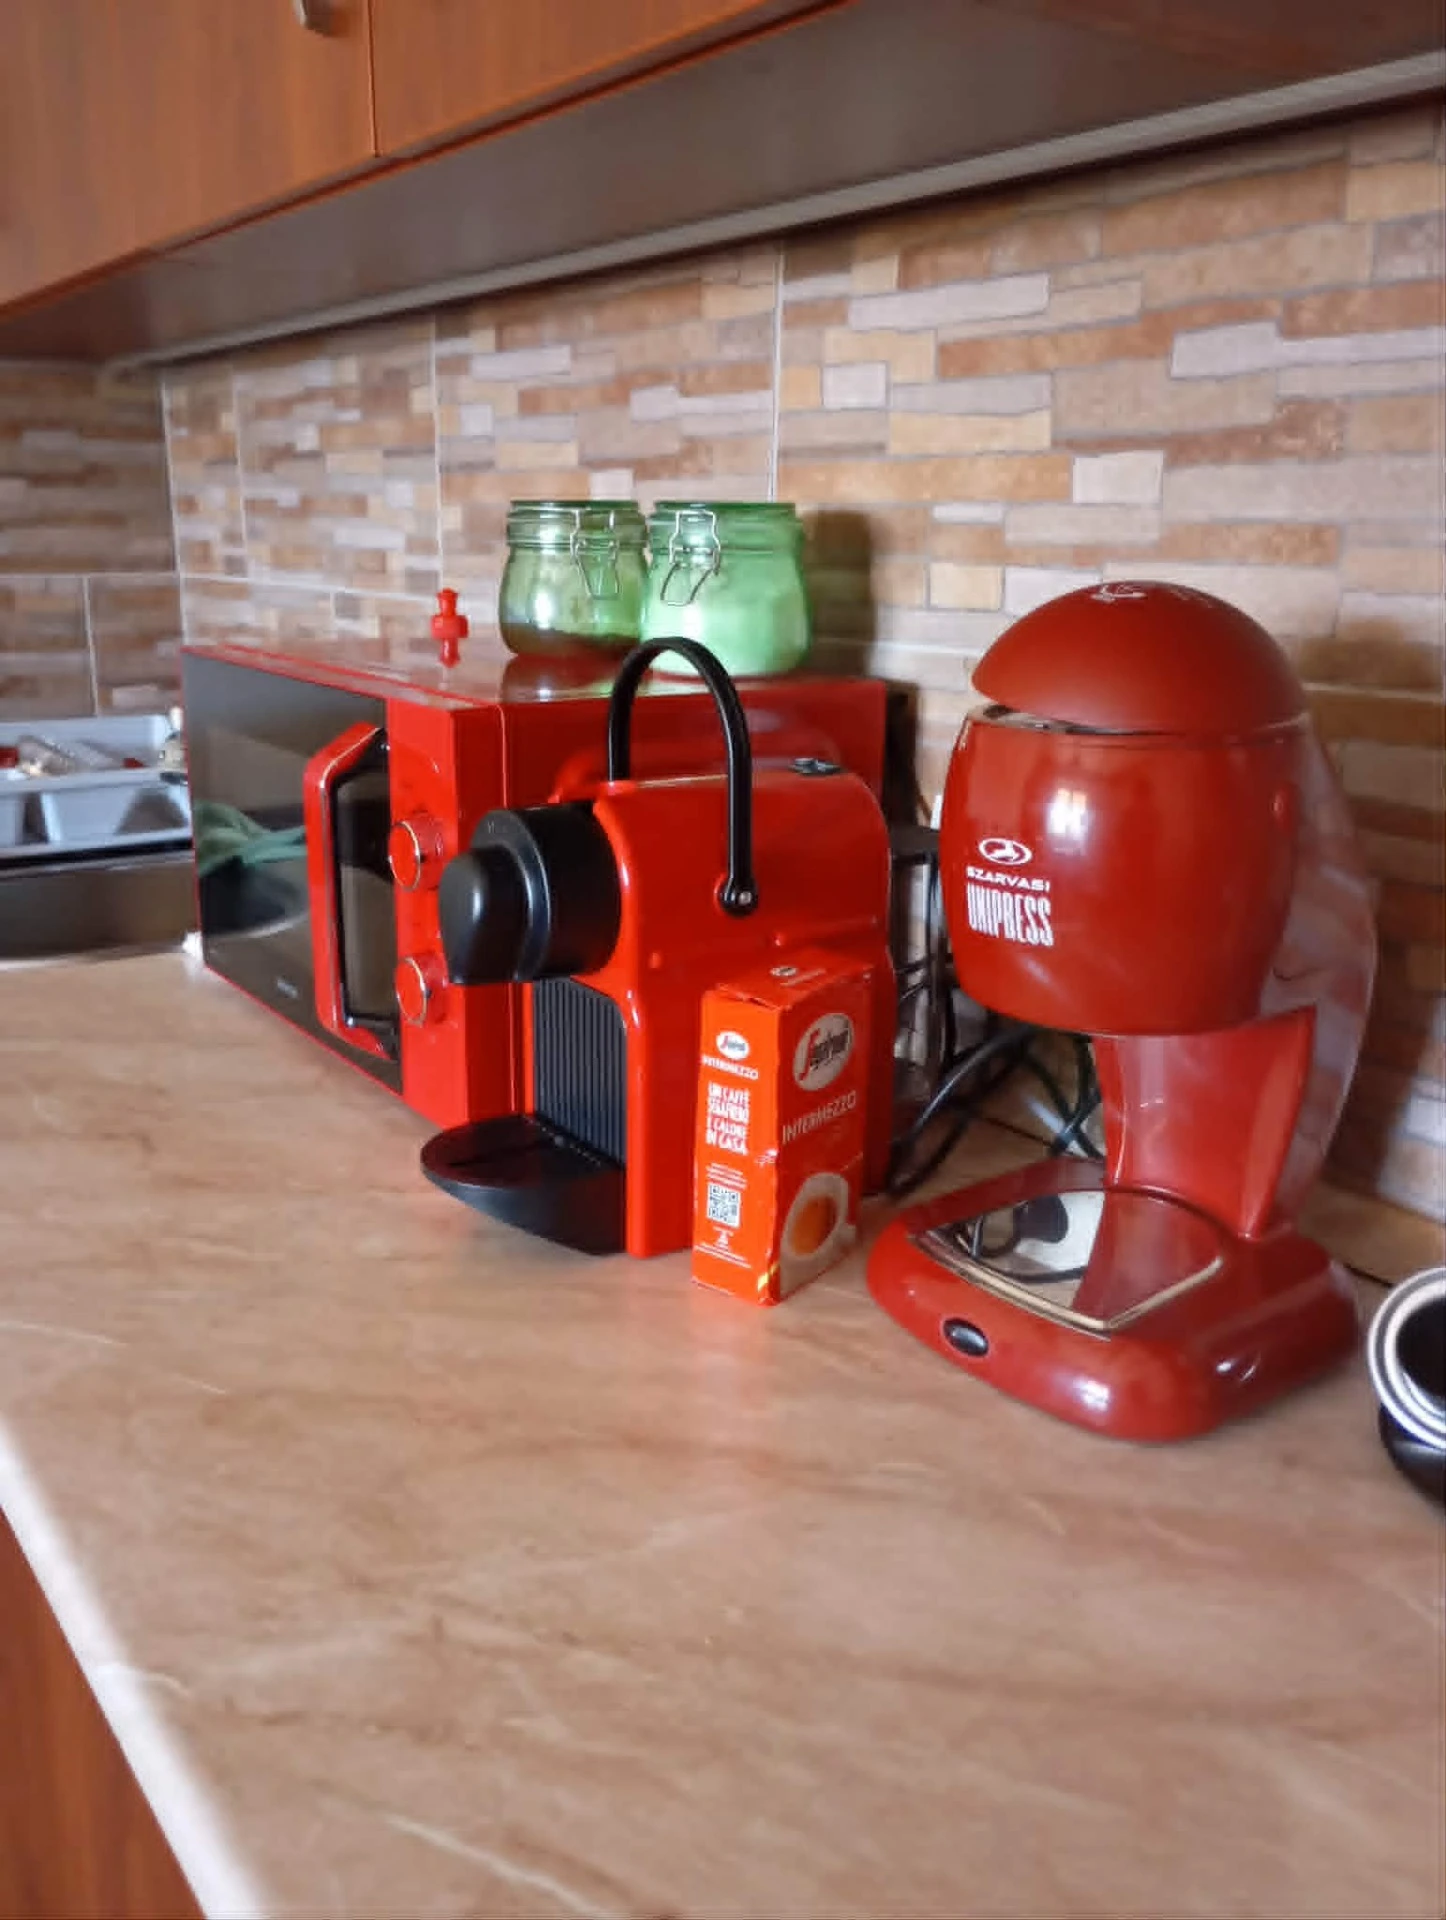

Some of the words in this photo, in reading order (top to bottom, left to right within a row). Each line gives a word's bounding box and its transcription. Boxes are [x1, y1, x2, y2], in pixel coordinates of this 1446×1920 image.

[966, 866, 1050, 892] SZARVASI
[967, 881, 1054, 946] UNIPRESS
[782, 1090, 856, 1145] INTERMEZZO
